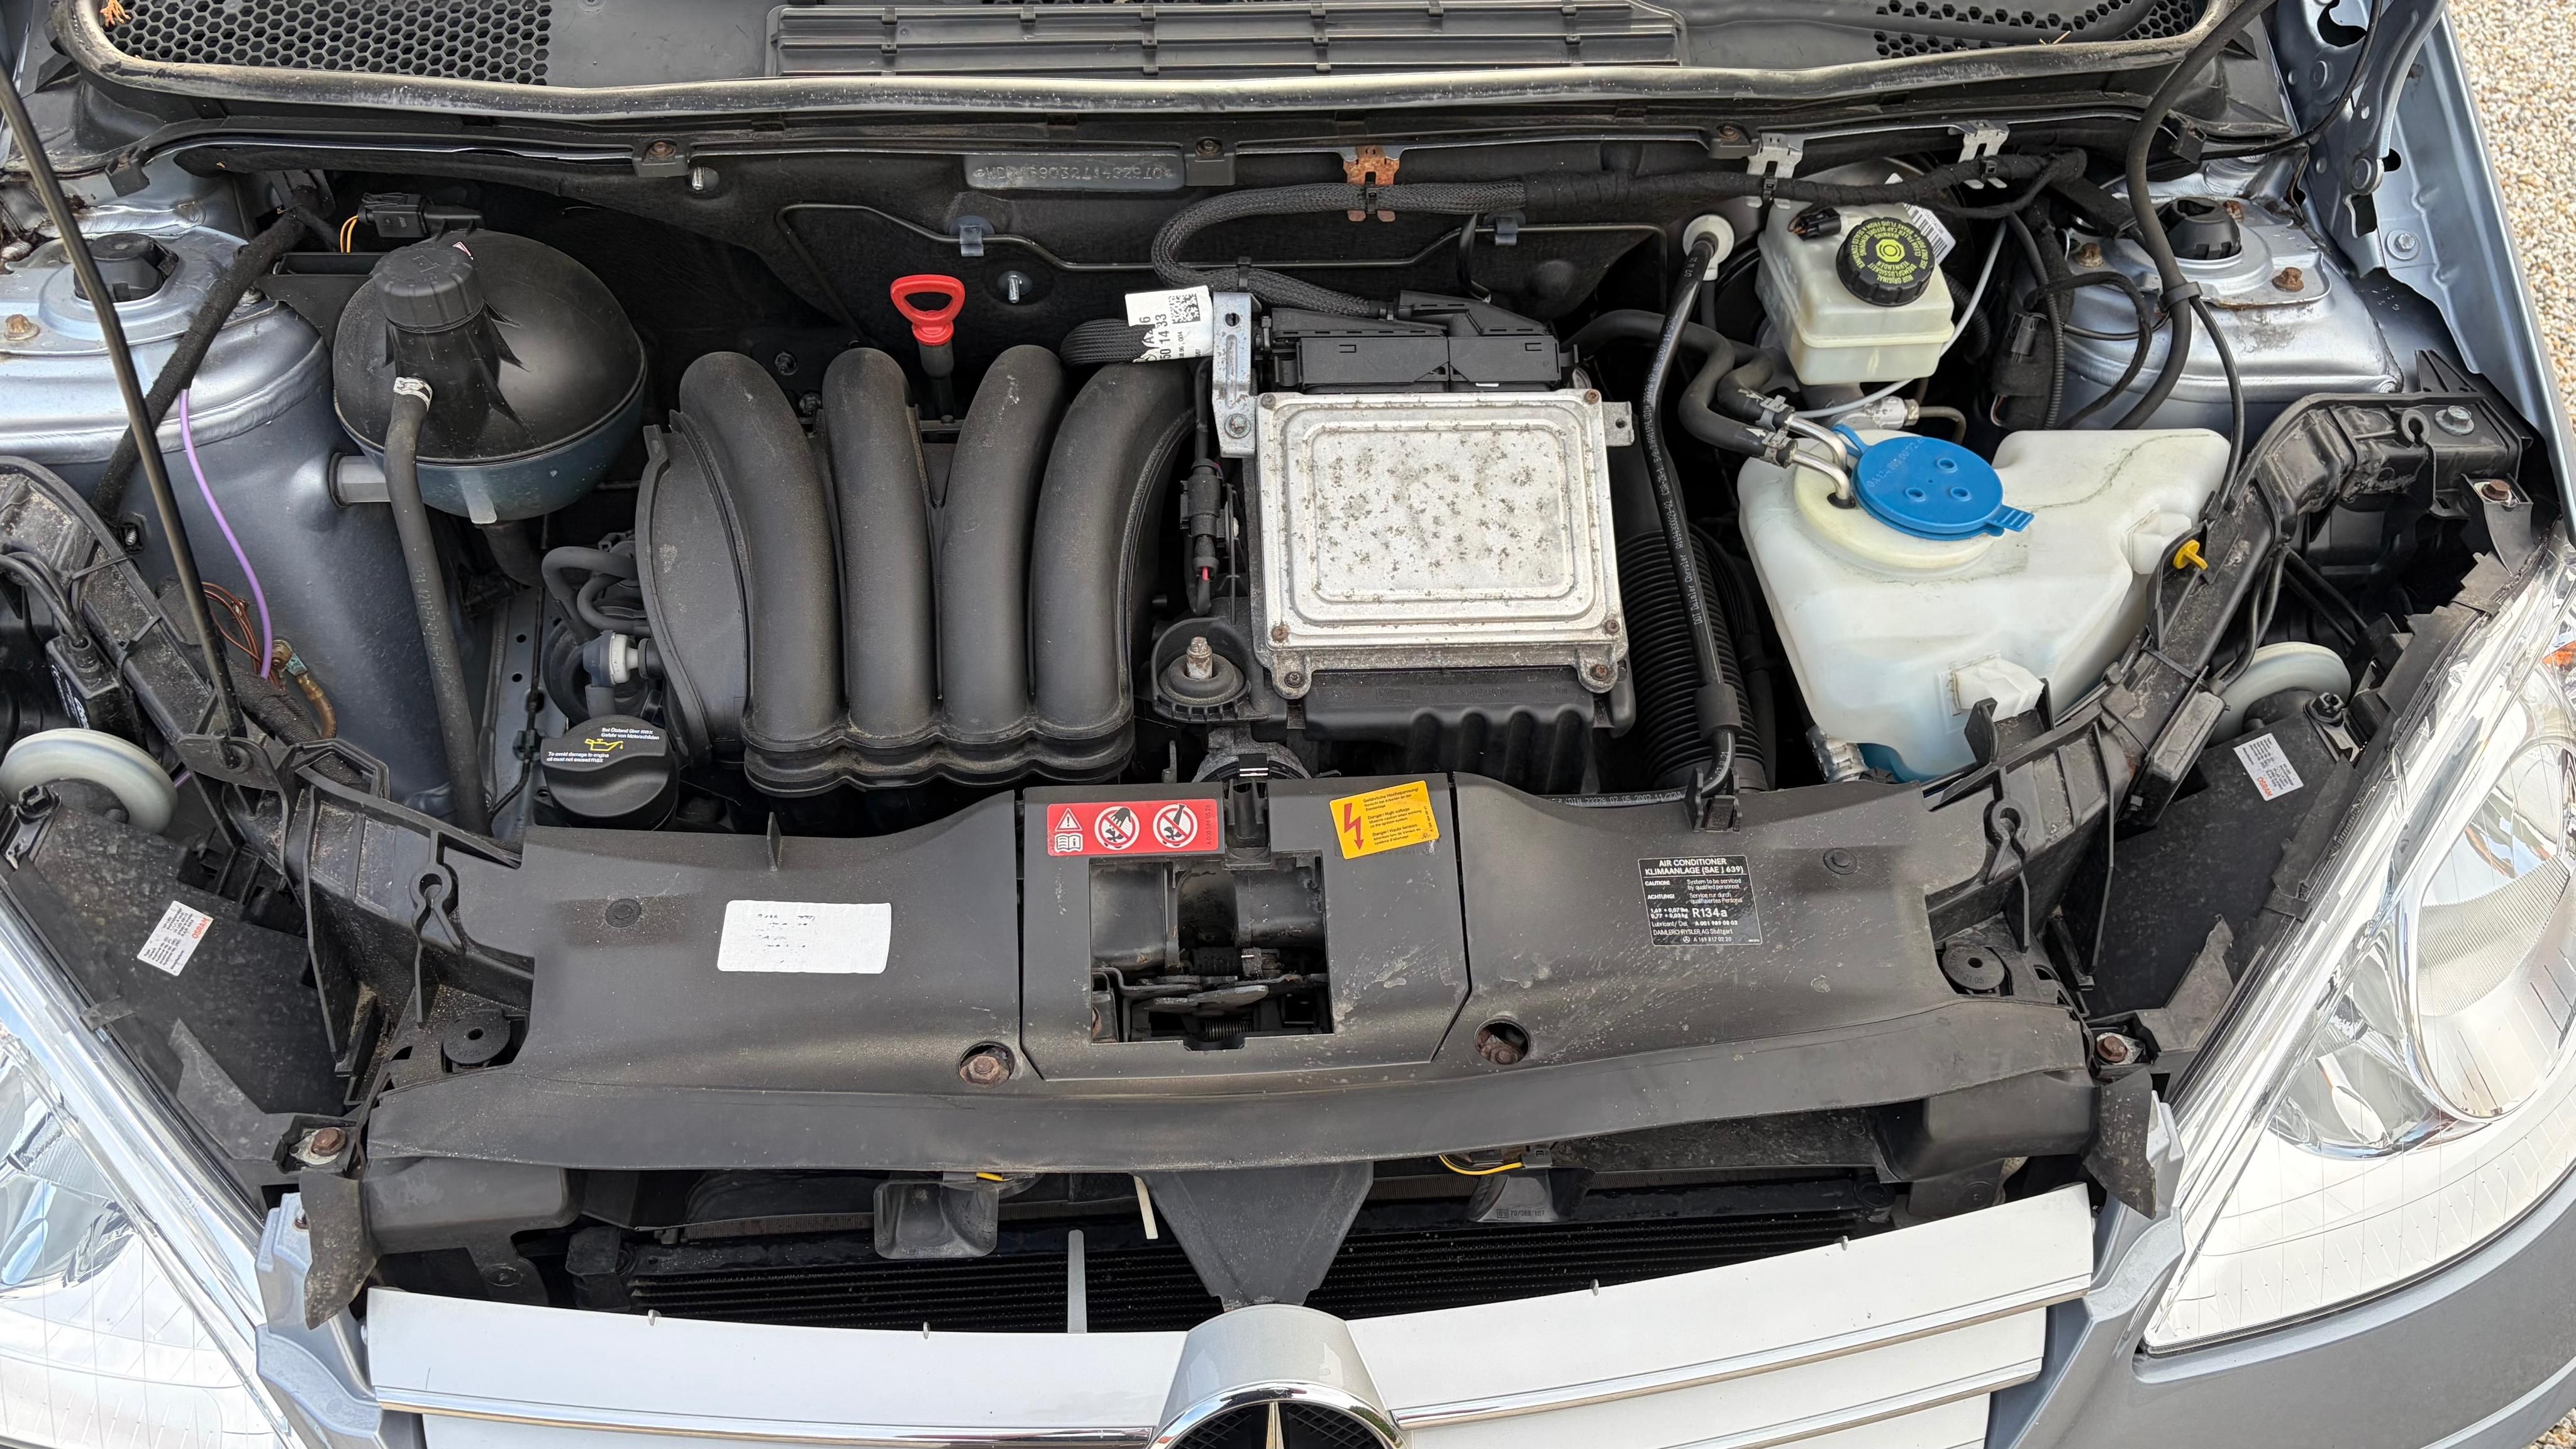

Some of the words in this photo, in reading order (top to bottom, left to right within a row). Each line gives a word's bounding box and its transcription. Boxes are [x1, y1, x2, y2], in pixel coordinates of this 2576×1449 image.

[1866, 221, 1881, 231] FROM
[1866, 226, 1886, 236] BEFORE
[1897, 224, 1914, 235] BRAKE
[1852, 230, 1865, 245] SEALED
[1898, 230, 1915, 243] FILLER
[1859, 234, 1870, 257] REMOVING
[1911, 242, 1921, 257] CLEAN
[1851, 245, 1865, 269] CONTAINER
[1876, 261, 1910, 270] VERWENDEN
[1919, 260, 1928, 269] USE
[1877, 274, 1902, 284] ORIGINAL
[1902, 274, 1914, 283] NUR
[1155, 314, 1168, 327] 33
[1158, 330, 1170, 344] 14
[2258, 776, 2273, 797] OSRAM
[1674, 858, 1727, 867] CONDITIONER
[1702, 866, 1719, 875] (SAE
[1726, 865, 1743, 874] 639)
[1692, 908, 1728, 918] R134a
[192, 917, 211, 939] OSRAM
